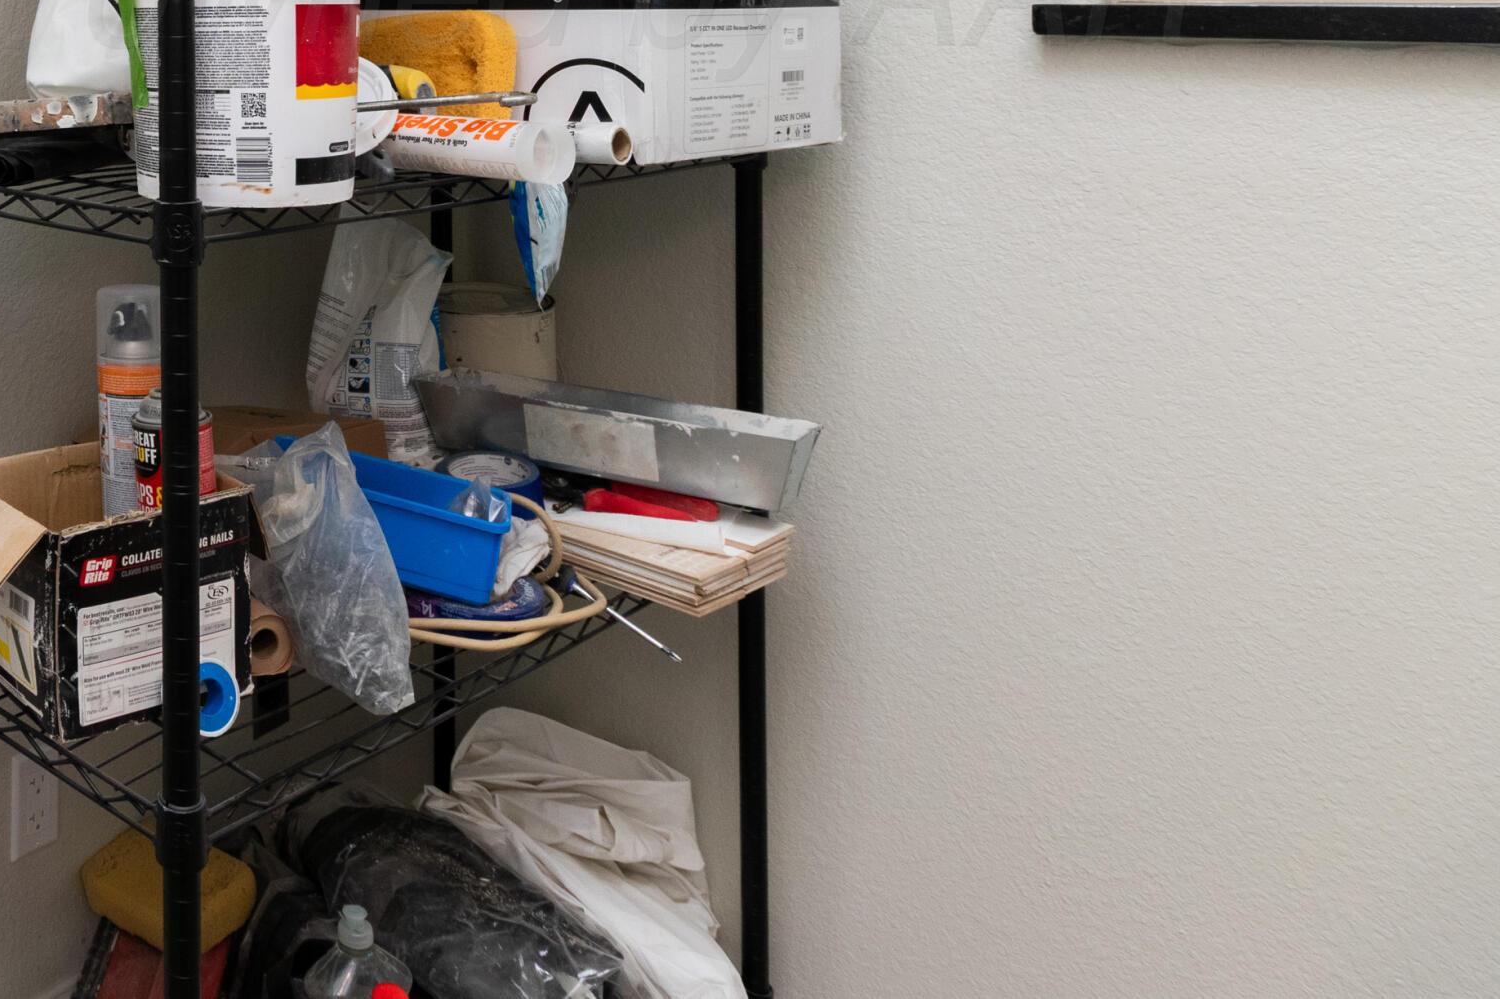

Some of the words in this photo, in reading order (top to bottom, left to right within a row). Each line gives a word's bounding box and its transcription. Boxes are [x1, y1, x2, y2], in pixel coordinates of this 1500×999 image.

[774, 114, 789, 122] MADE
[790, 113, 795, 121] IN
[434, 138, 446, 146] Seal
[453, 139, 468, 147] Caulk
[133, 430, 156, 449] REAT
[133, 447, 157, 465] TUFF
[210, 530, 234, 546] NAILS
[121, 548, 163, 566] COLLATE
[86, 558, 113, 572] Grip
[84, 570, 110, 585] Rite
